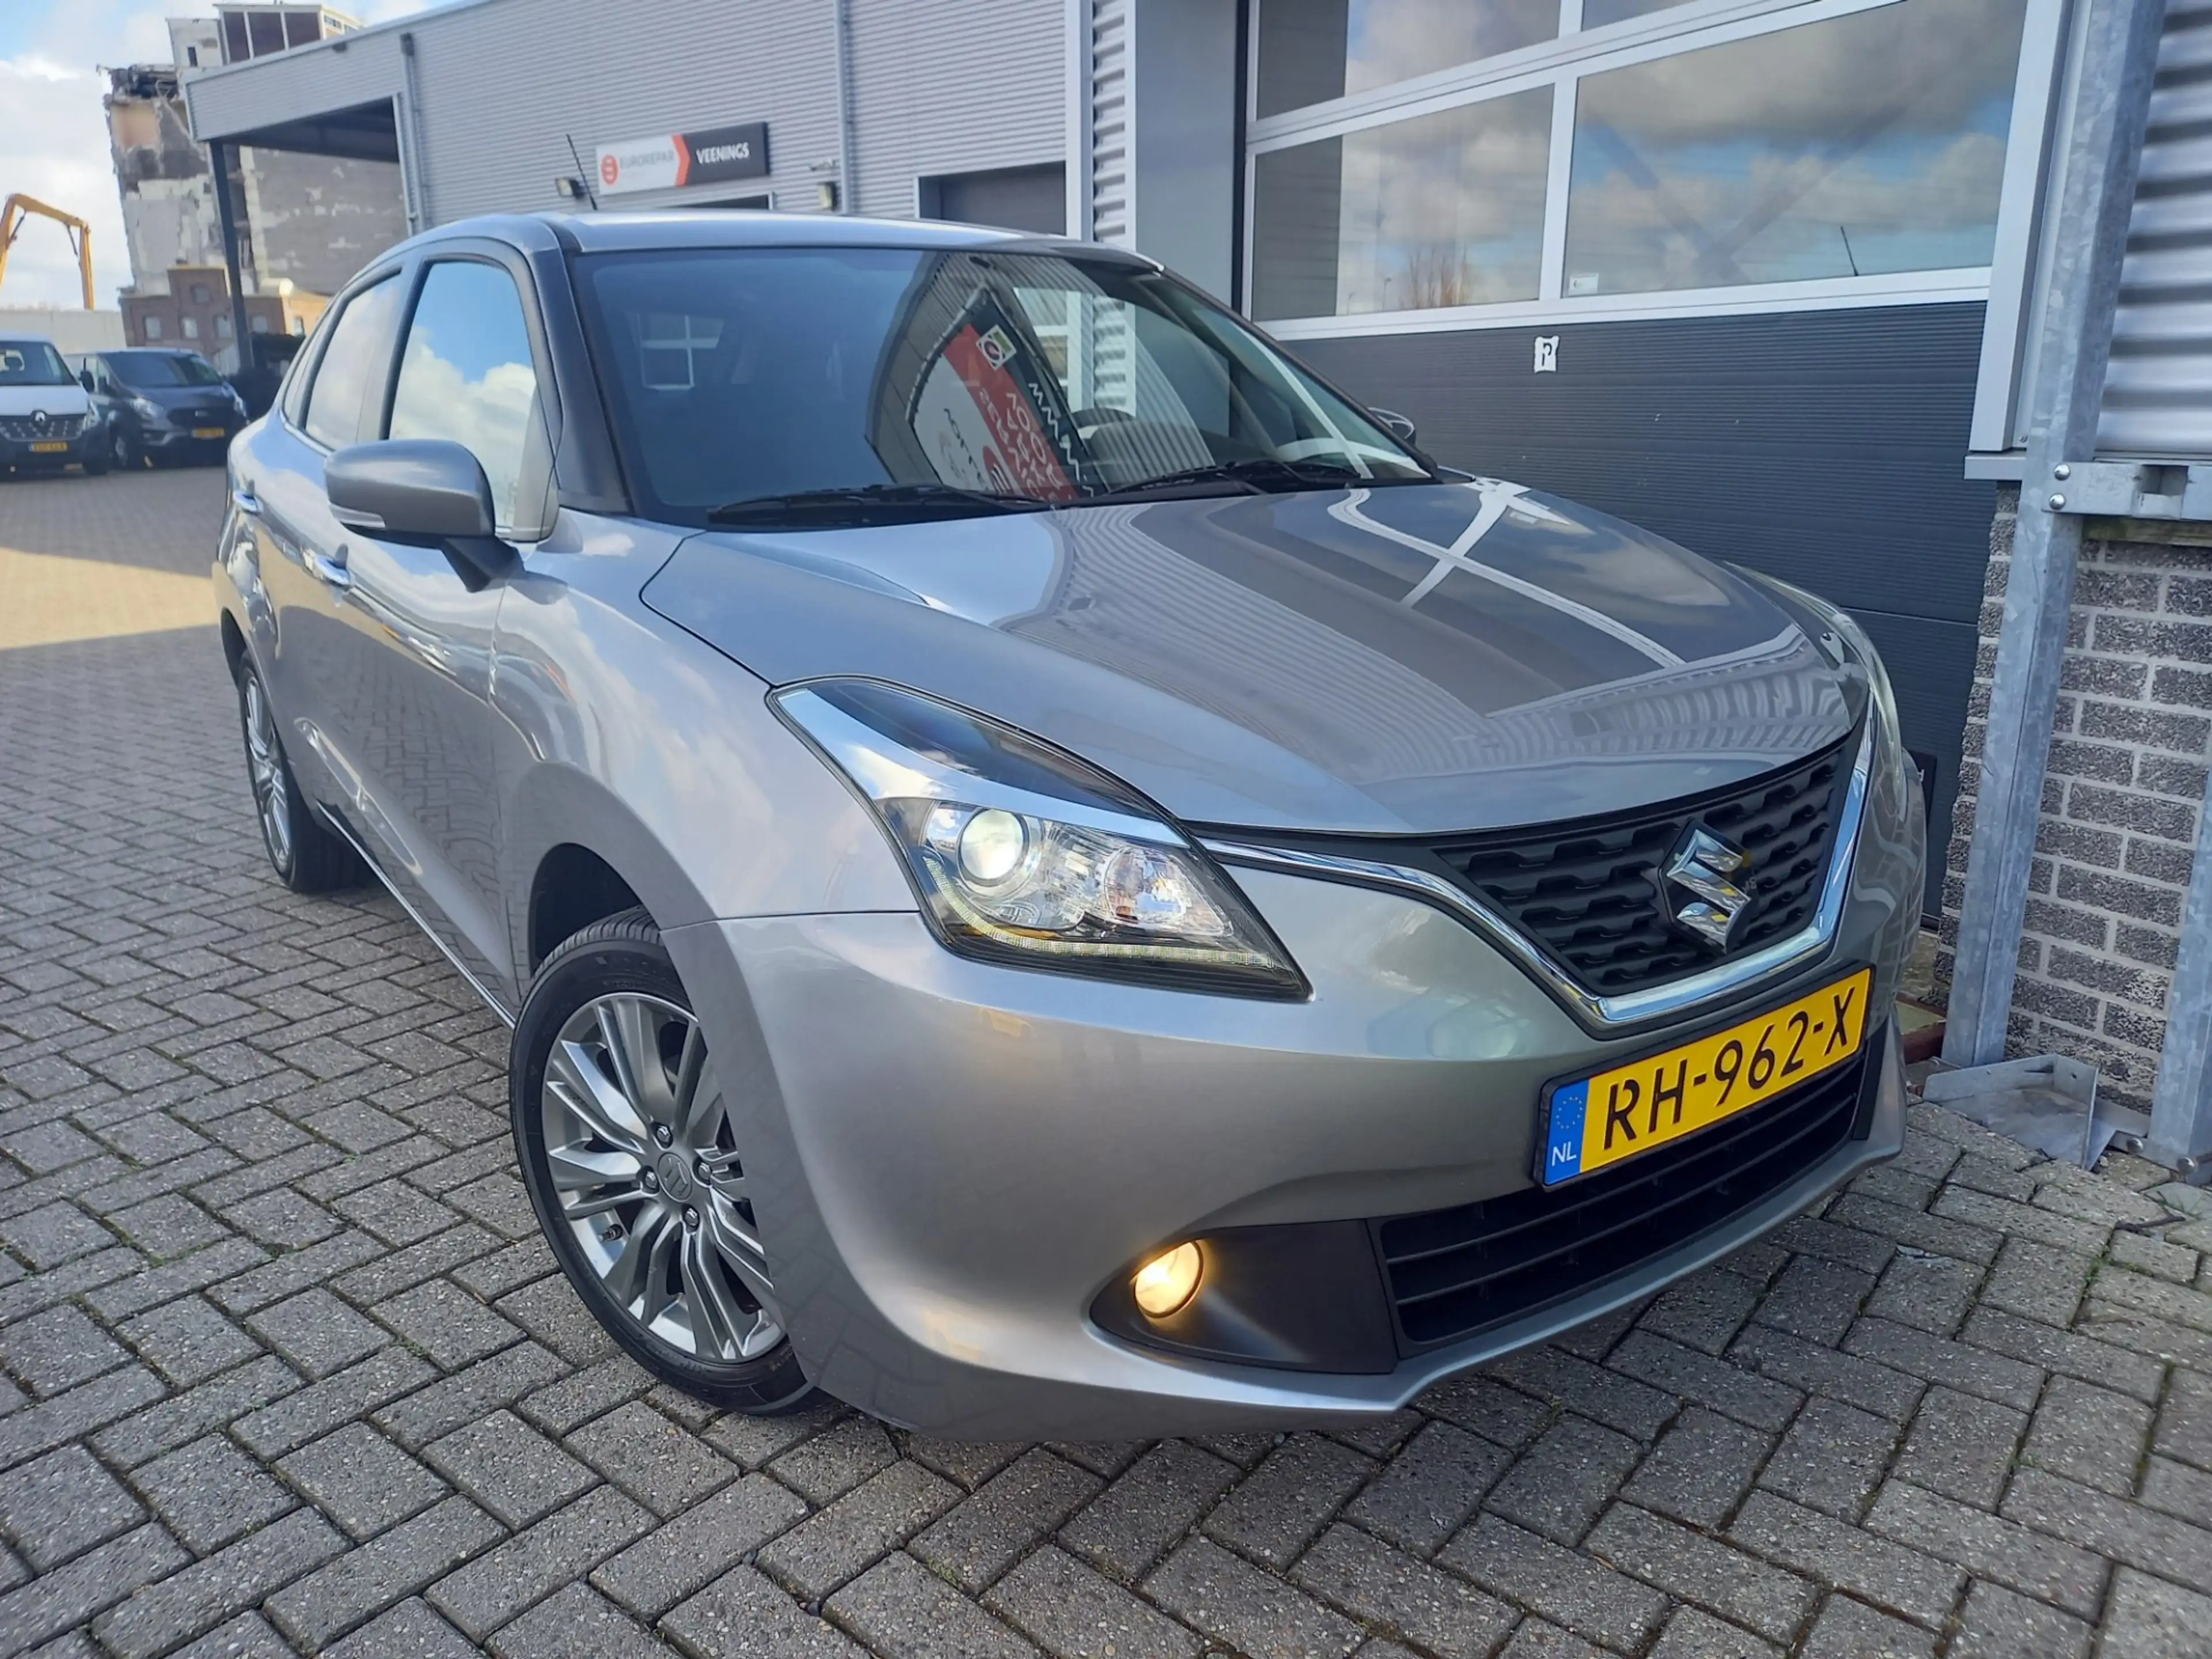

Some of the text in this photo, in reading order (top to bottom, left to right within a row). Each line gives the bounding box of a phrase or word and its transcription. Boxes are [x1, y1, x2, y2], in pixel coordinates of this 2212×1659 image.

[695, 142, 750, 165] VEENINGS
[1604, 987, 1855, 1150] RH-962-X
[1550, 1141, 1577, 1167] NL
